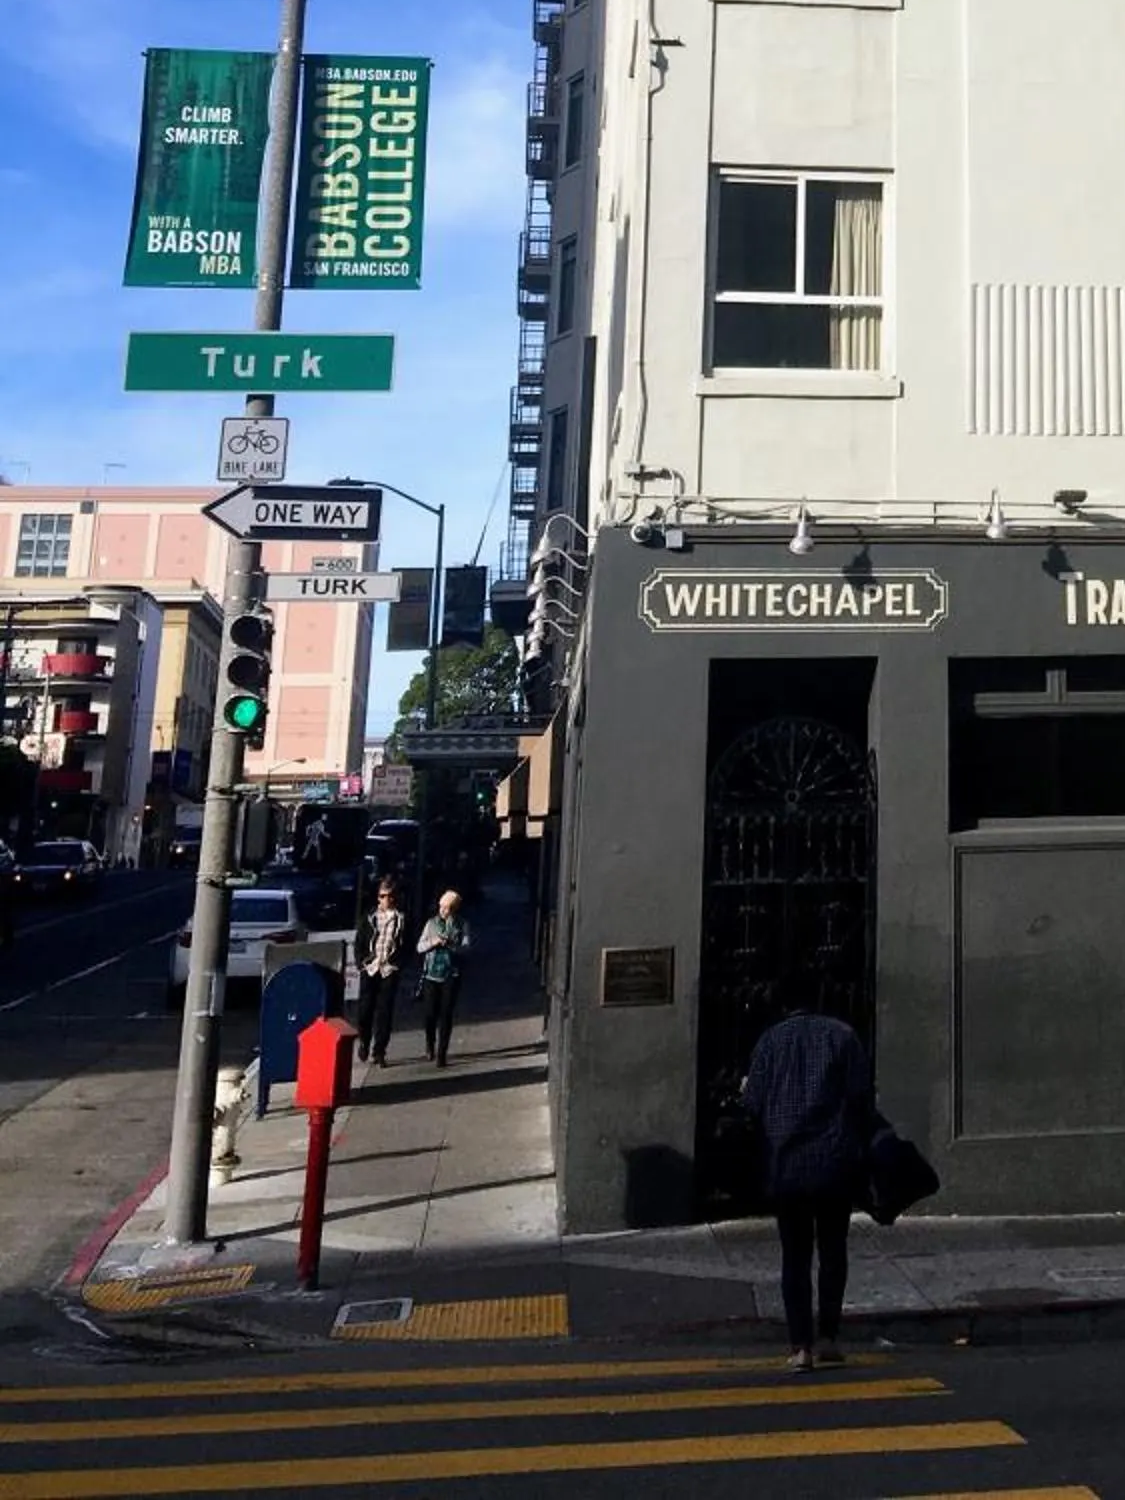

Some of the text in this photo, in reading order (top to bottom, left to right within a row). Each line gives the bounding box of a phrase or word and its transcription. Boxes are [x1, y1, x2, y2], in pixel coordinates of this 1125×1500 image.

[181, 105, 232, 123] CLIMB
[165, 127, 244, 145] SMARTER.
[305, 83, 365, 258] BABSON
[364, 85, 418, 258] COLLEGE
[148, 216, 192, 229] WITH A
[147, 230, 242, 254] BABSON
[199, 255, 242, 275] MBA
[303, 261, 409, 277] SAN FRANCISCO
[200, 347, 323, 379] Turk
[223, 461, 279, 475] BIKE LANE
[255, 503, 362, 525] ONE WAY
[298, 578, 367, 595] TURK
[664, 582, 922, 618] WHITECHAPEL
